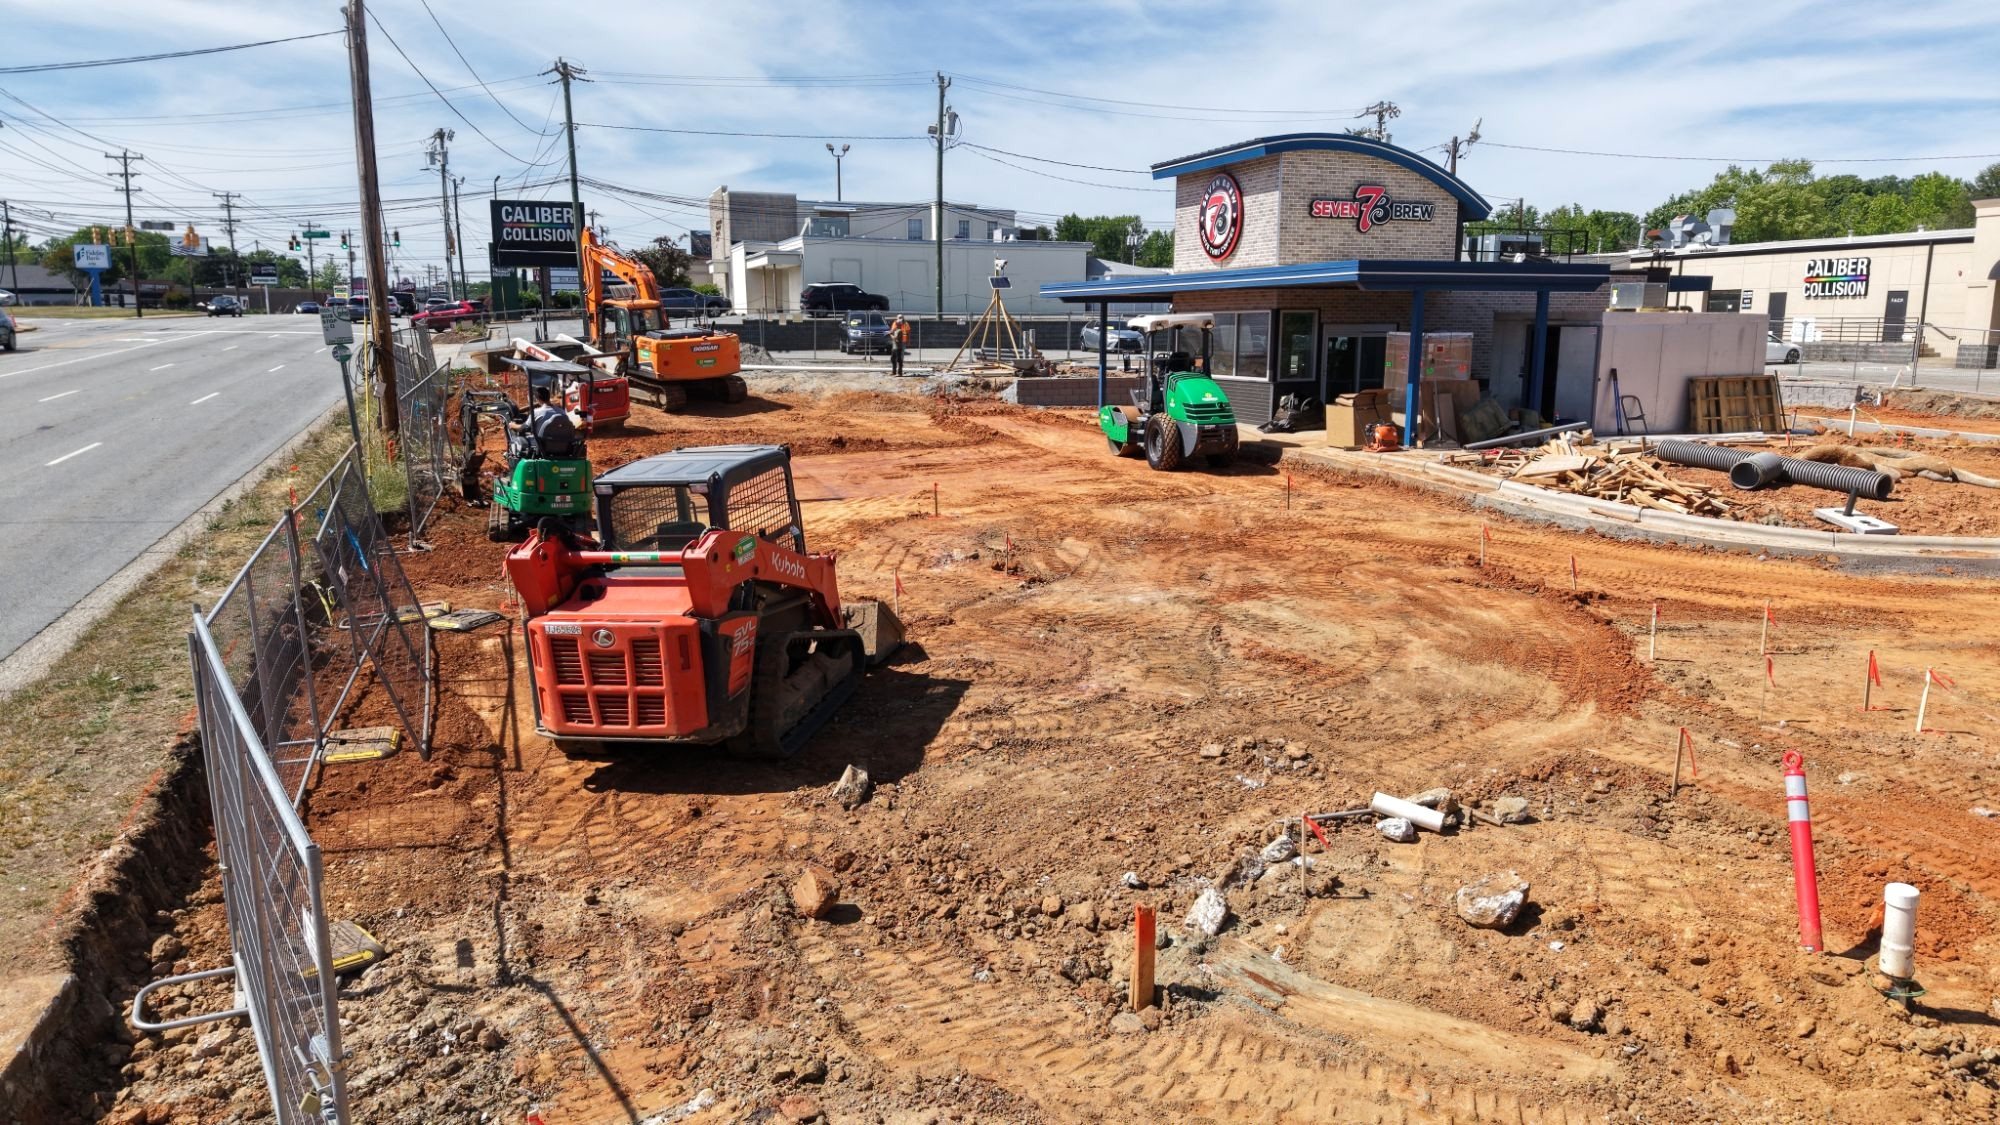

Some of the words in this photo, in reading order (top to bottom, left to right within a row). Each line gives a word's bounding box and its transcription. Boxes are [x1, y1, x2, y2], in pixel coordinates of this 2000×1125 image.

[501, 205, 574, 224] CALIBER
[1312, 200, 1360, 217] SEVEN
[1392, 203, 1435, 221] BREW
[502, 227, 576, 242] COLLISION
[1804, 258, 1868, 277] CALIBER
[1802, 281, 1867, 297] COLLISION
[771, 551, 806, 579] Kubota
[734, 620, 757, 642] SVL
